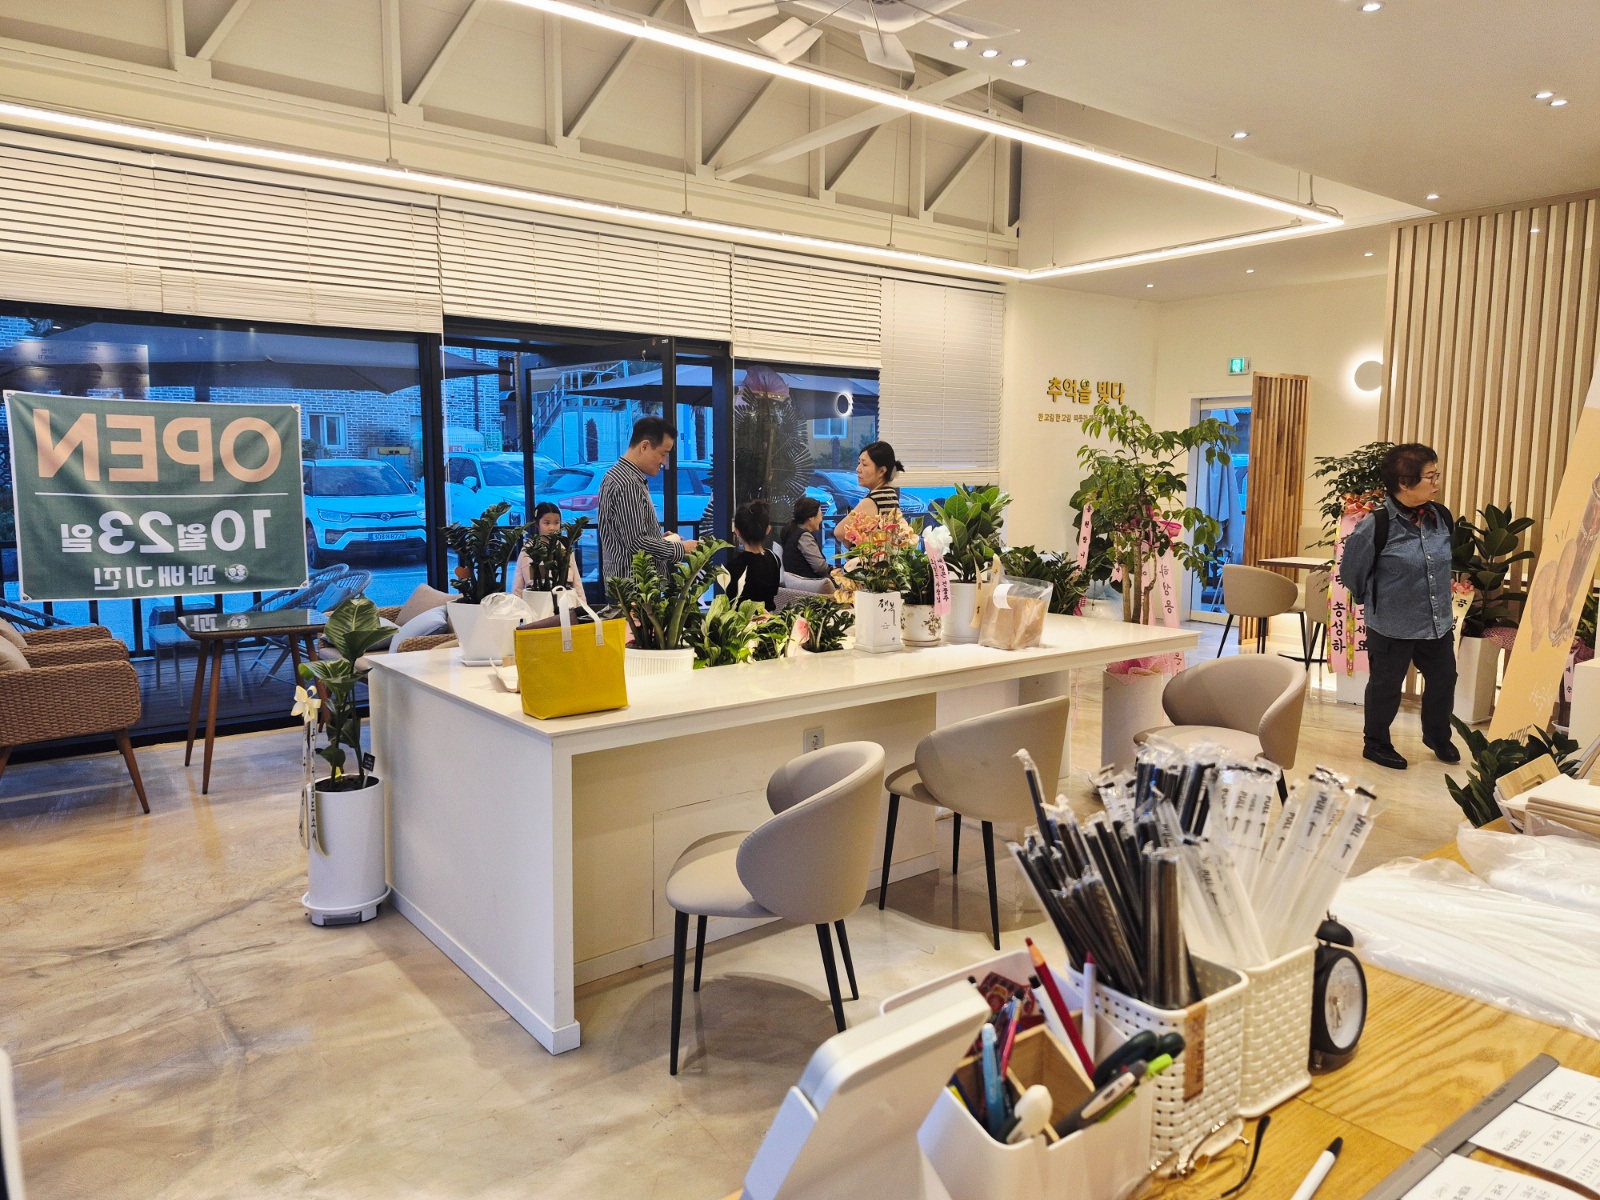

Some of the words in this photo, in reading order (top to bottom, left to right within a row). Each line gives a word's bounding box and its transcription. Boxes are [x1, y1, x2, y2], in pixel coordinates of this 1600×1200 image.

[1047, 377, 1092, 404] 추억을
[878, 599, 896, 627] 행복
[1331, 601, 1347, 655] 송성하
[1235, 790, 1248, 809] PULL
[1262, 795, 1272, 815] PULL
[1282, 811, 1296, 830] PULL
